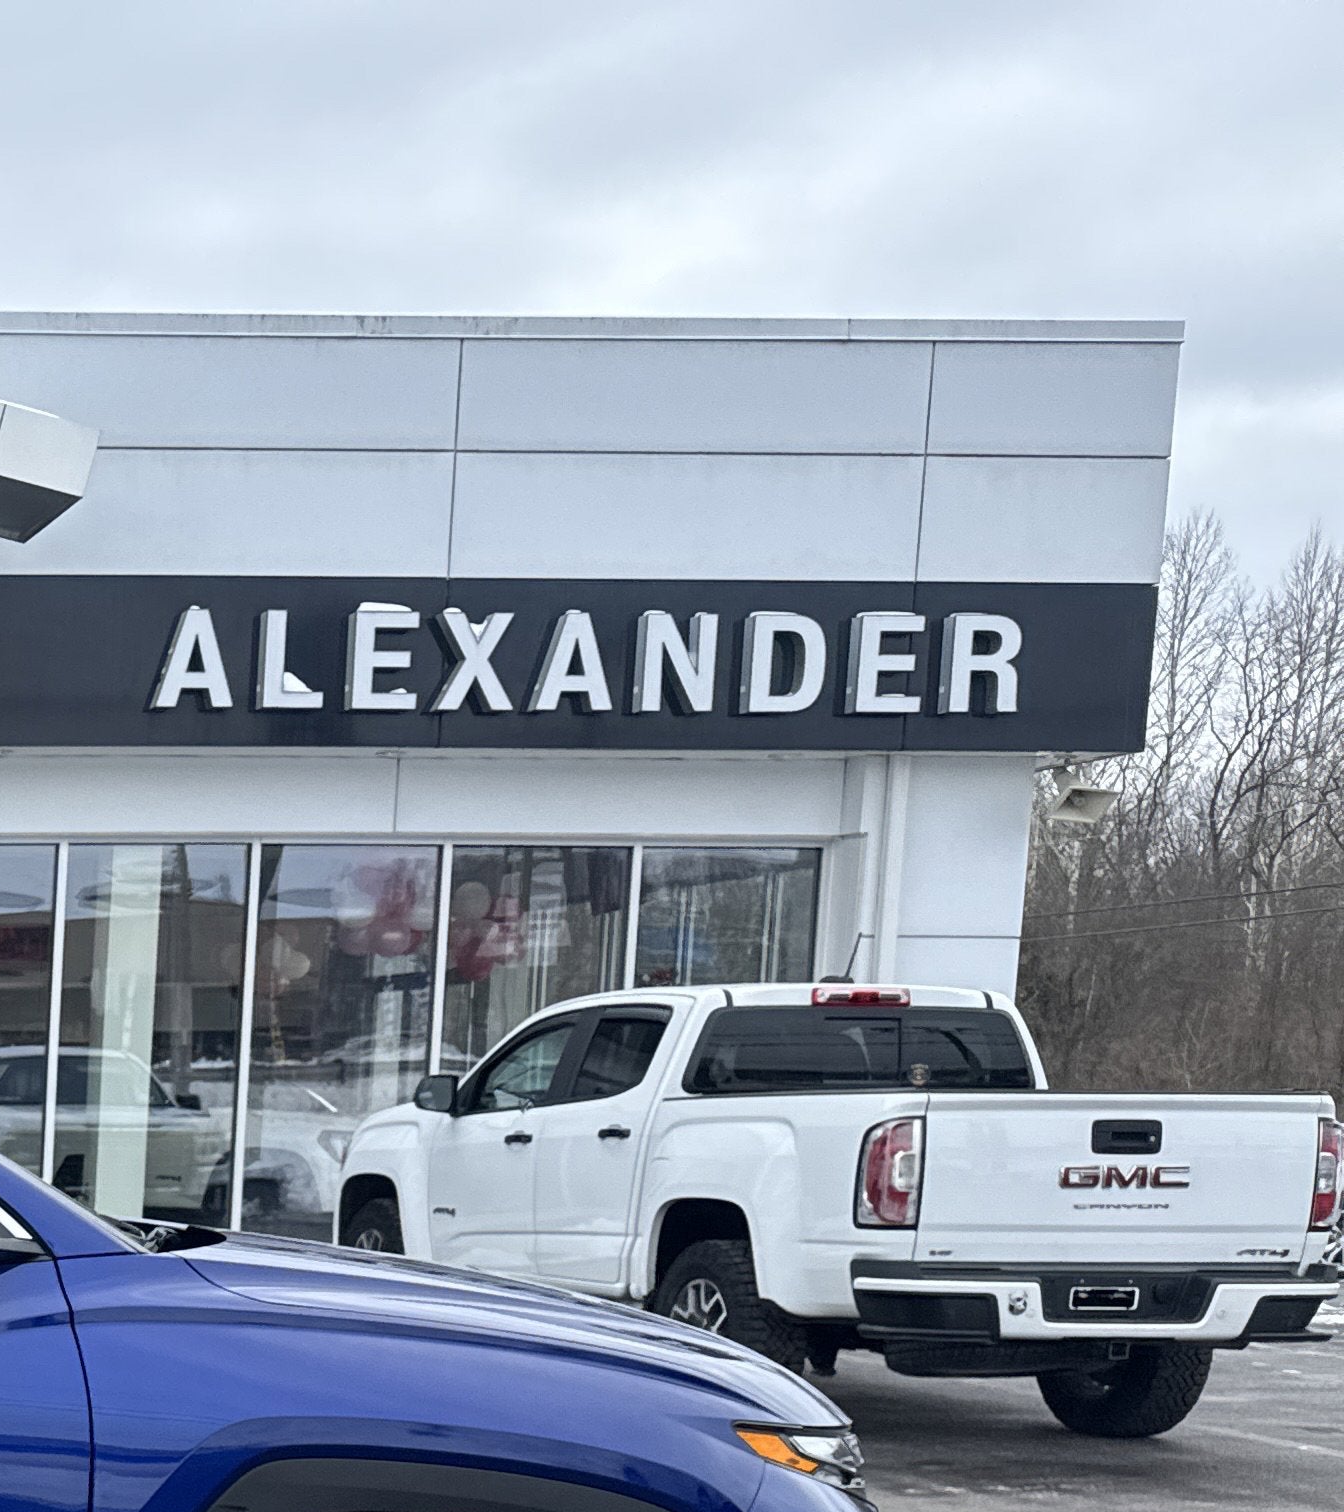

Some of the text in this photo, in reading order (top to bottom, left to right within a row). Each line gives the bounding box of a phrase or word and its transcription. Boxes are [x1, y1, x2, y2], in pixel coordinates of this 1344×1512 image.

[150, 604, 1024, 716] ALEXANDER
[1059, 1164, 1190, 1189] GMC
[1072, 1202, 1170, 1211] CANYON
